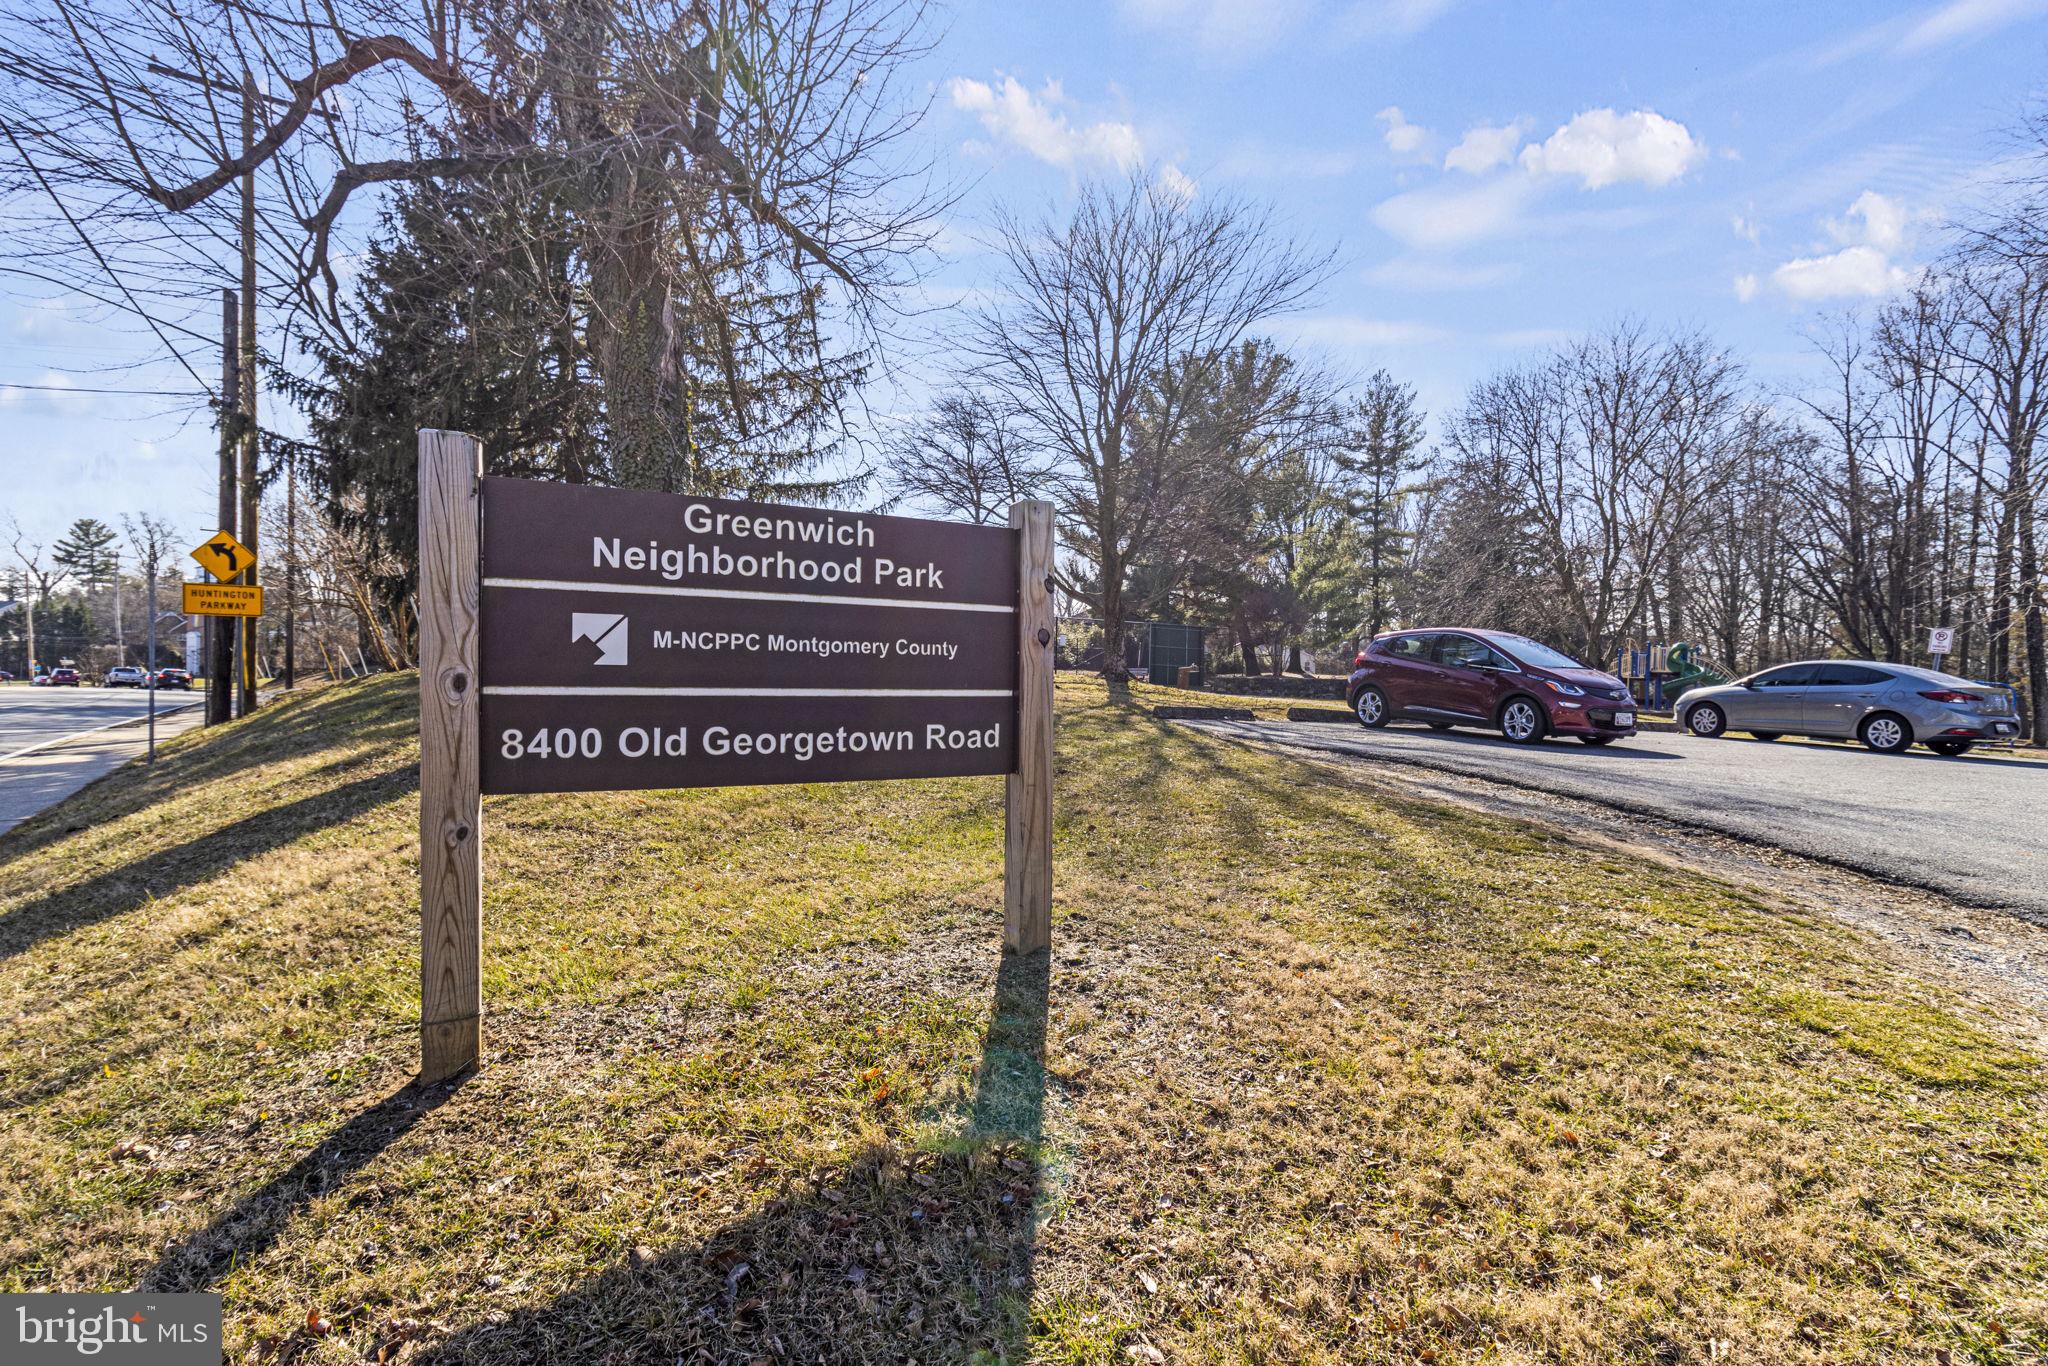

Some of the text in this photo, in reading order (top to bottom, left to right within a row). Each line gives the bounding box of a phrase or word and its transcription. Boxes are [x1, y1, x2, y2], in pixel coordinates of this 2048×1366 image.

[684, 503, 876, 547] Greenwich
[592, 536, 945, 589] Neighborhood Park
[191, 589, 256, 600] HUNTINGTON
[200, 600, 247, 610] PARKWAY
[653, 630, 959, 660] M-NCPPC Montgomery County
[500, 722, 1001, 761] 8400 Old Georgetown Road
